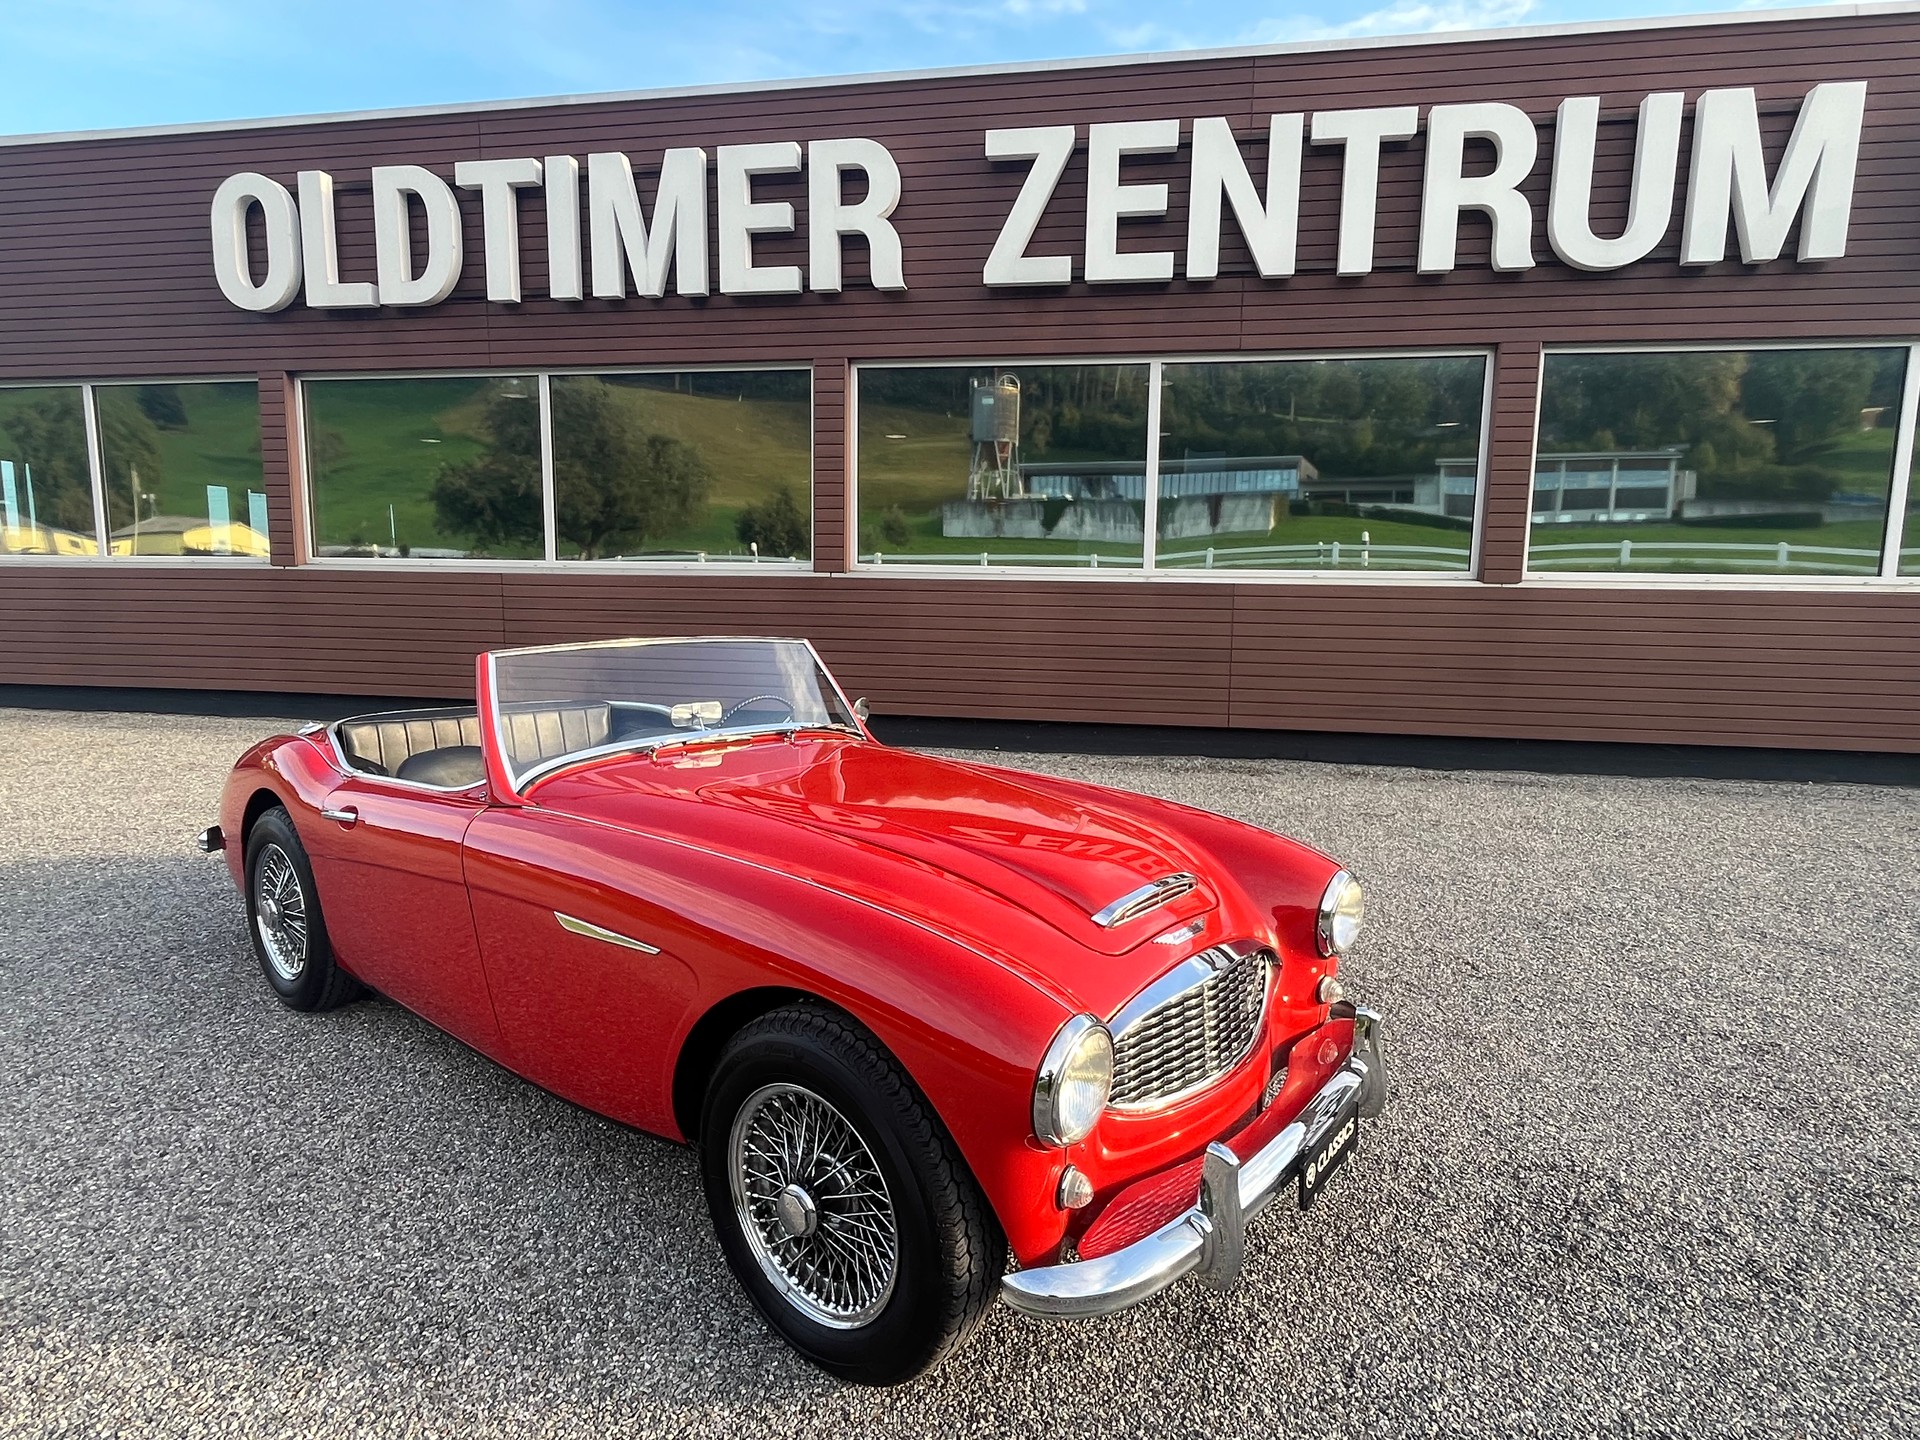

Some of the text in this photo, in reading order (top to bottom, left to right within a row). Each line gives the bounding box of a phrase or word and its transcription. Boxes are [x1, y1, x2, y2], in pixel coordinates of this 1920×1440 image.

[210, 81, 1868, 312] OLDTIMER ZENTRUM
[1317, 1117, 1355, 1173] CLASSICS
